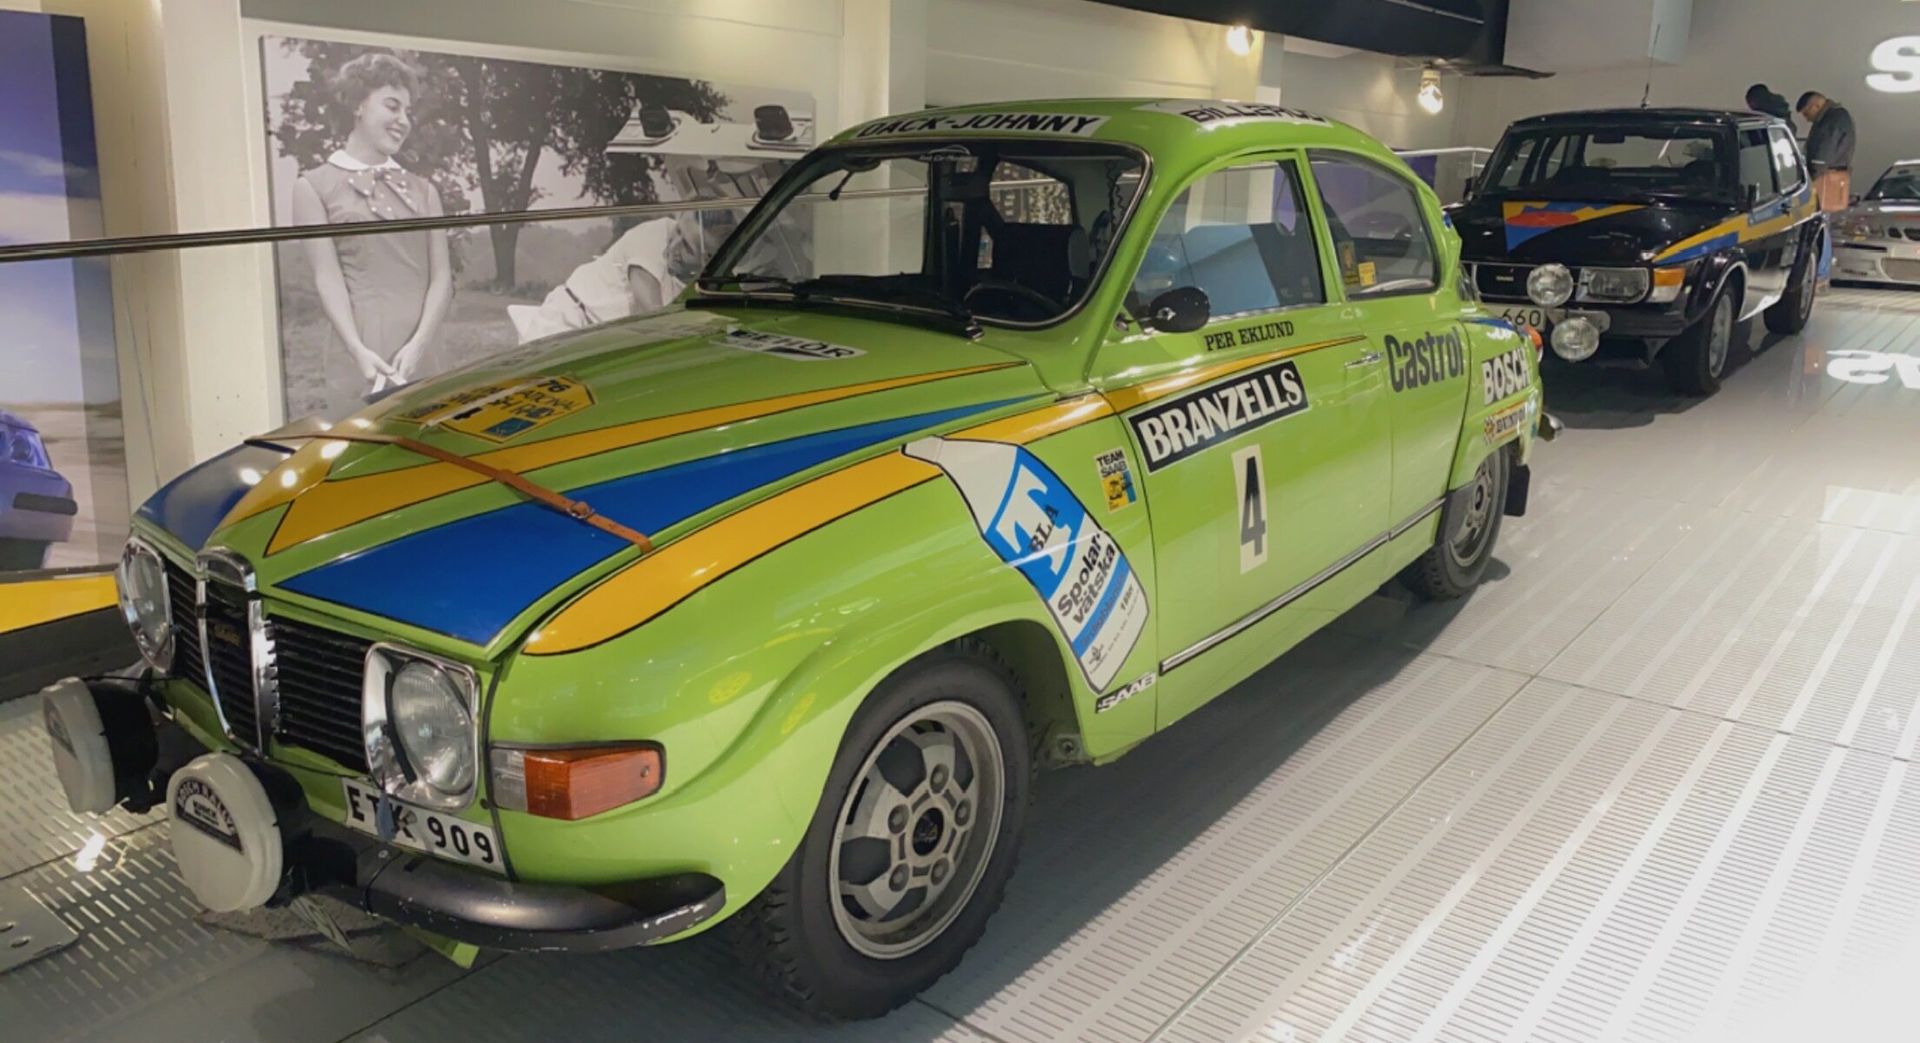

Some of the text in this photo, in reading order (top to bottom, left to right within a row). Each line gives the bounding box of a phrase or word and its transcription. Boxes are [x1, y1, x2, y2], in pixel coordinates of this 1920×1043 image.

[1204, 320, 1295, 351] PER EKLUND
[1384, 326, 1465, 393] Castrol
[1482, 346, 1531, 406] BOSCH
[1138, 368, 1303, 464] BRANZELLS
[1096, 450, 1124, 467] TEAM
[1240, 455, 1267, 557] 4
[1096, 675, 1156, 712] SAAB
[427, 816, 494, 864] 909
